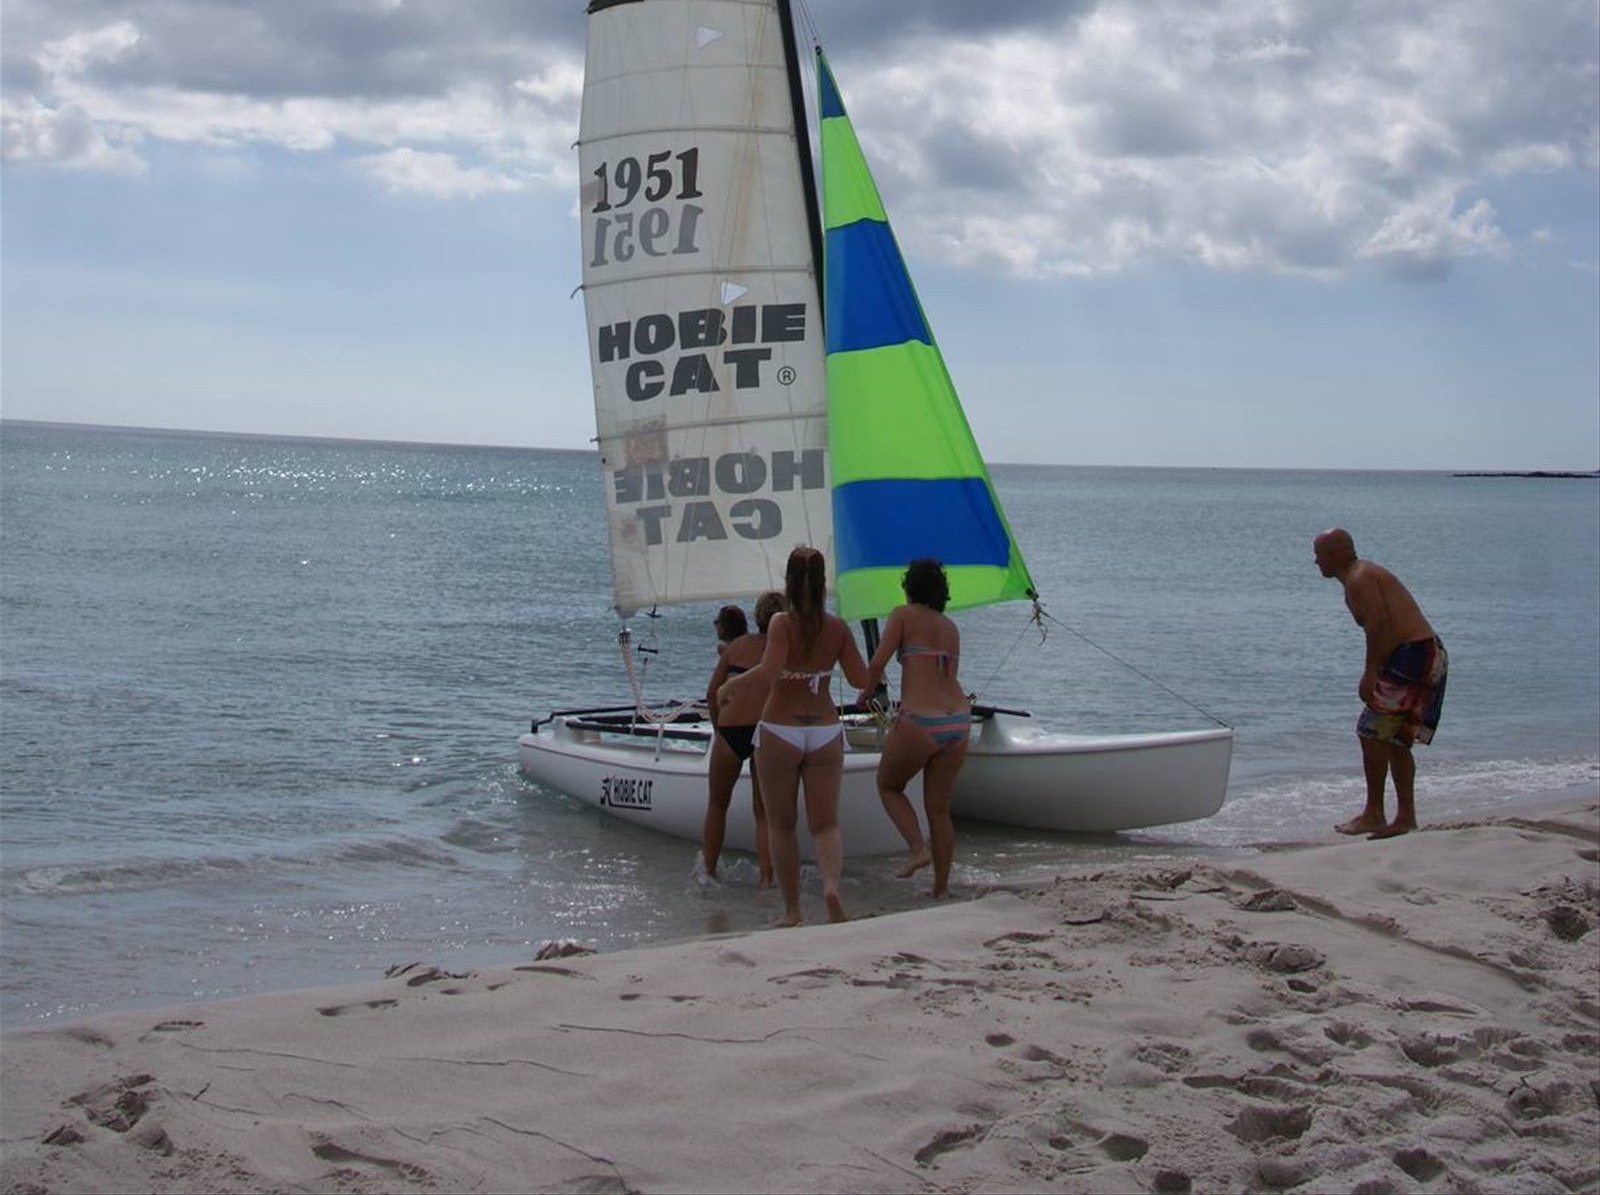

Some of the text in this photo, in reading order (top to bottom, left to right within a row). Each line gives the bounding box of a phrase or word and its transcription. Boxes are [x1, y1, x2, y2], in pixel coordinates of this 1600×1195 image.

[592, 147, 703, 214] 1951
[599, 303, 806, 363] HOBIE
[625, 348, 771, 402] CAT
[613, 779, 653, 804] HOBIE CAT
